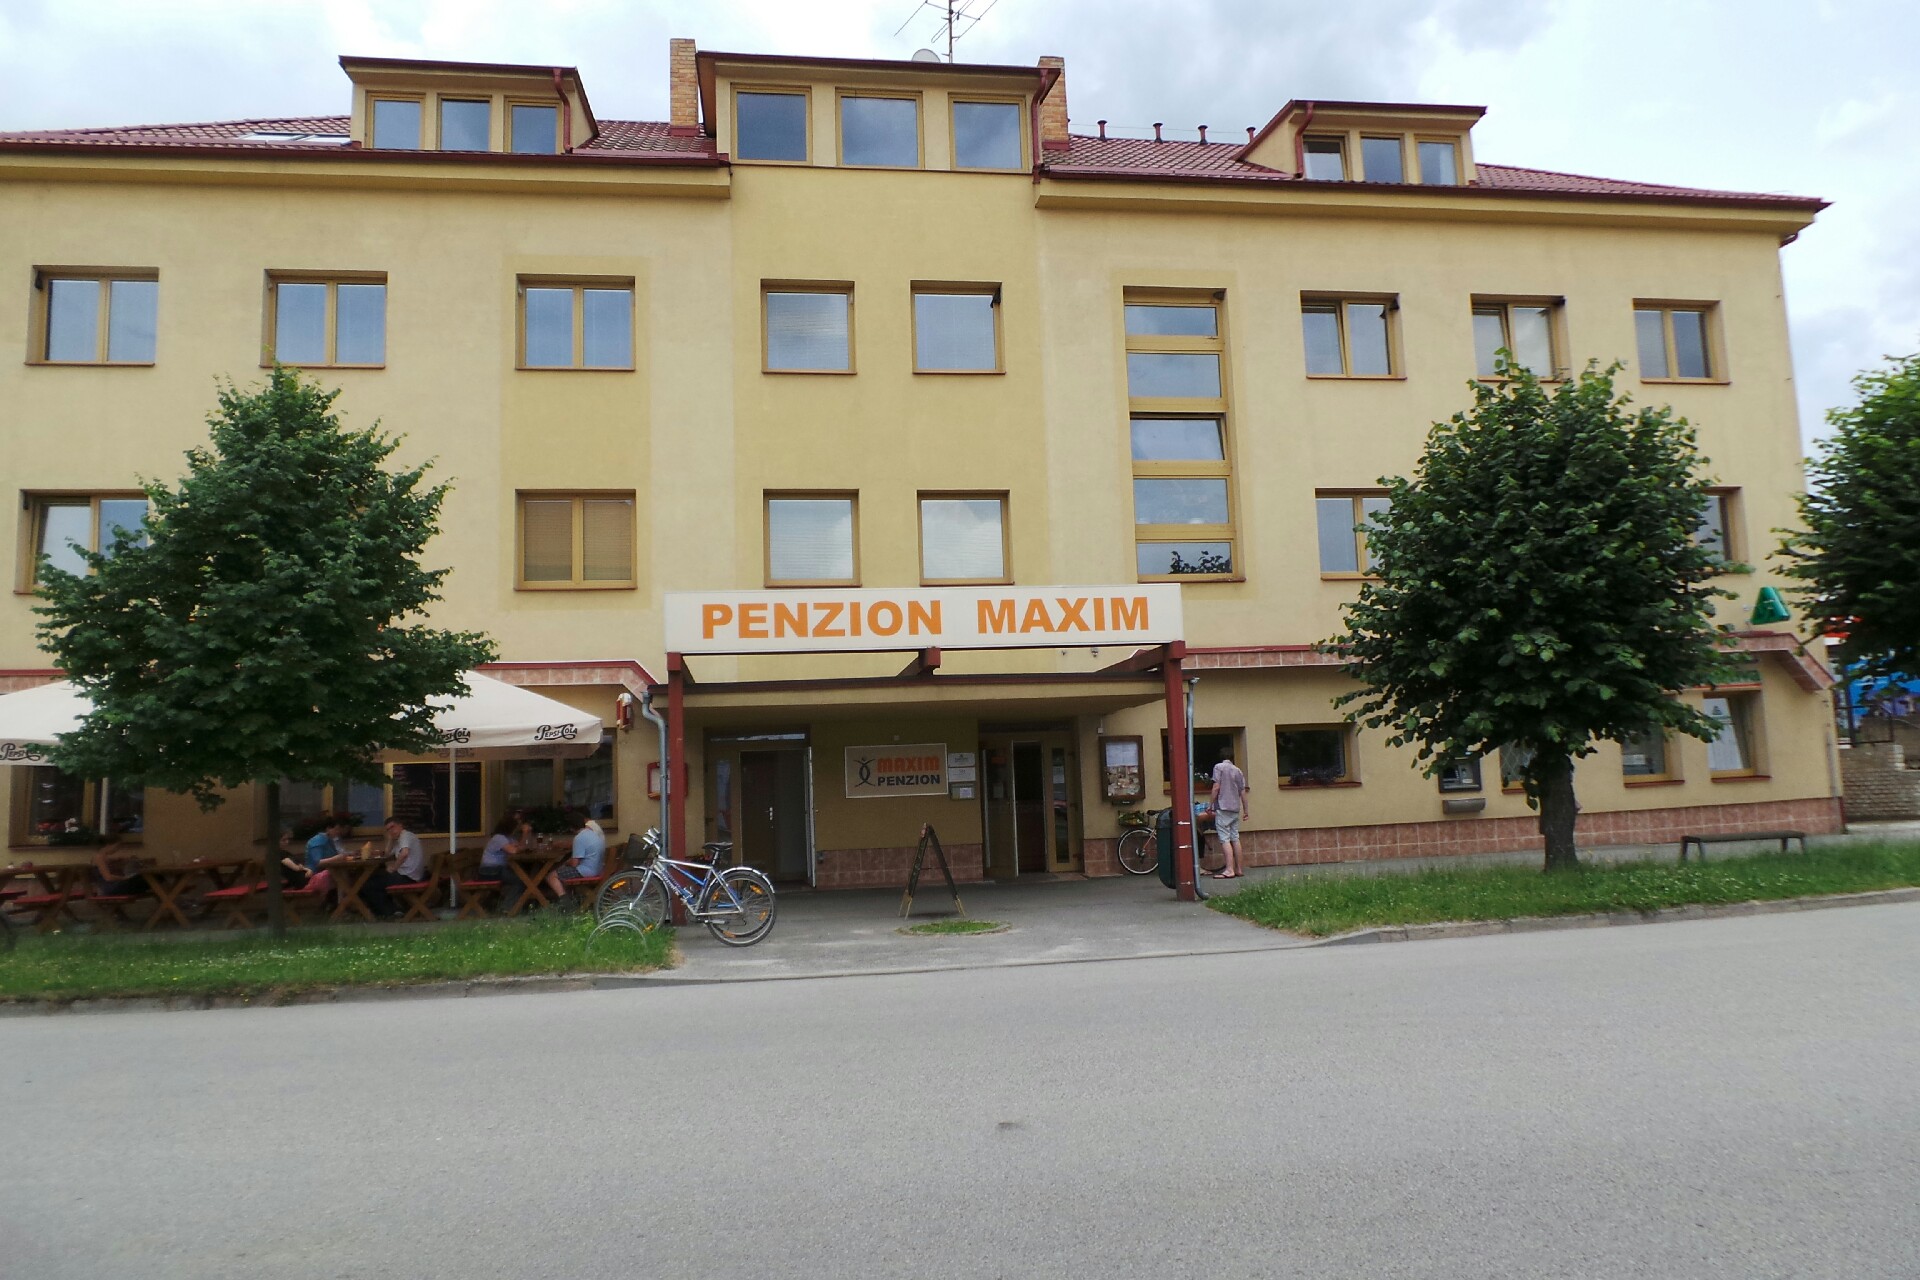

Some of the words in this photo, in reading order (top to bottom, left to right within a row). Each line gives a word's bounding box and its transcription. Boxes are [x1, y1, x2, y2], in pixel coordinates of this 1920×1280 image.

[702, 600, 943, 640] PENZION
[977, 596, 1150, 633] MAXIM
[877, 756, 941, 774] MAXIM
[877, 775, 941, 787] PENZION
